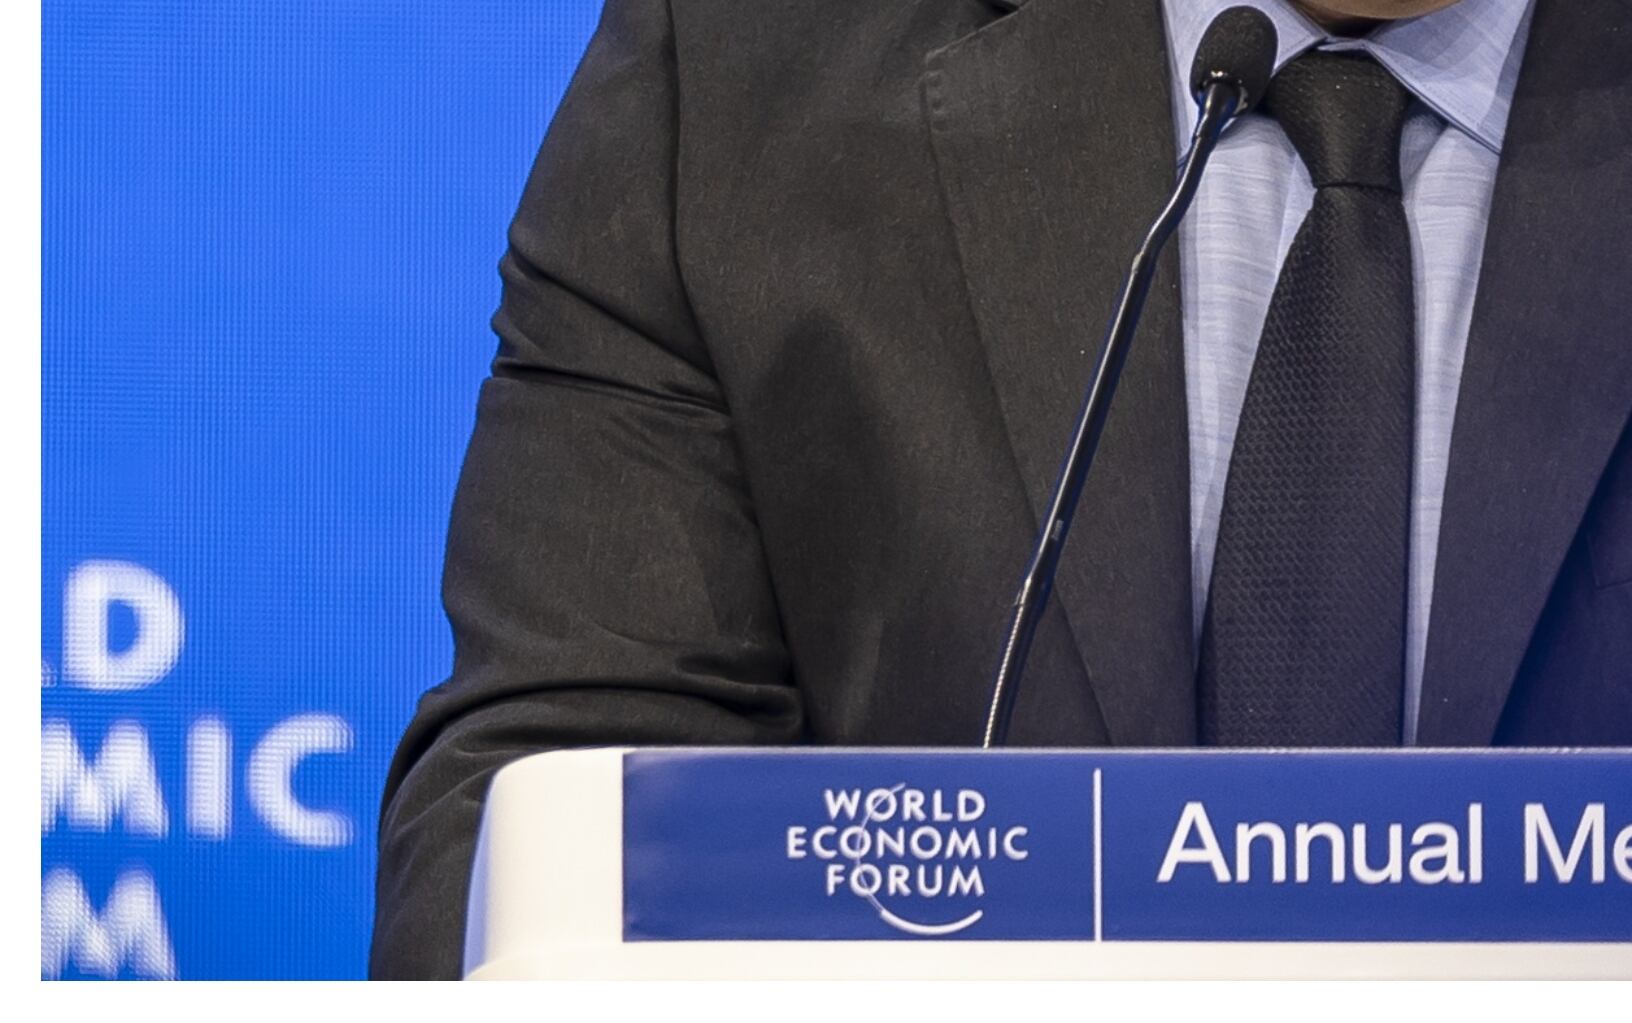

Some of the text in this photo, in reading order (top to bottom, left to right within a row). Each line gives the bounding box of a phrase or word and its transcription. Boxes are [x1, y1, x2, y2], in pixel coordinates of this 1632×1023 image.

[824, 787, 986, 822] WORLD
[786, 826, 1029, 860] ECONOMIC
[1156, 801, 1483, 884] Annual
[825, 864, 985, 897] FORUM
